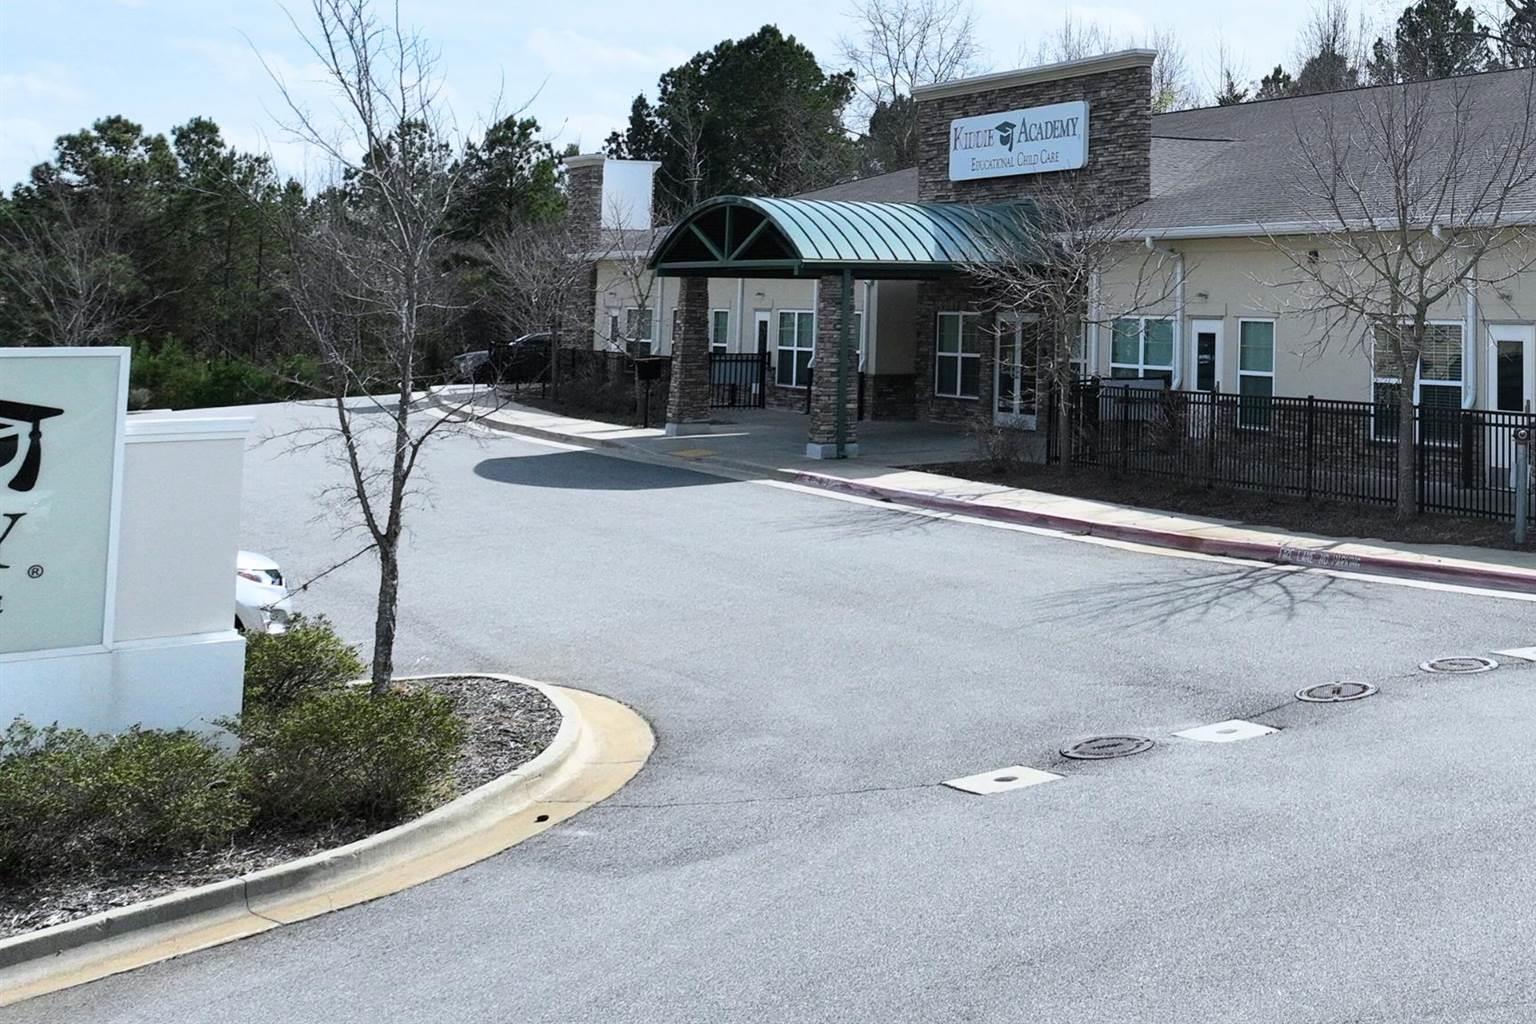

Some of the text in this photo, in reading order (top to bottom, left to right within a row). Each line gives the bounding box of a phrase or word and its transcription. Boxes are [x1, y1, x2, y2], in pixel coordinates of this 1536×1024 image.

[953, 117, 1079, 151] KIDDIE ACADEMY
[971, 149, 1059, 171] EDUCATIONAL CHILD CARE
